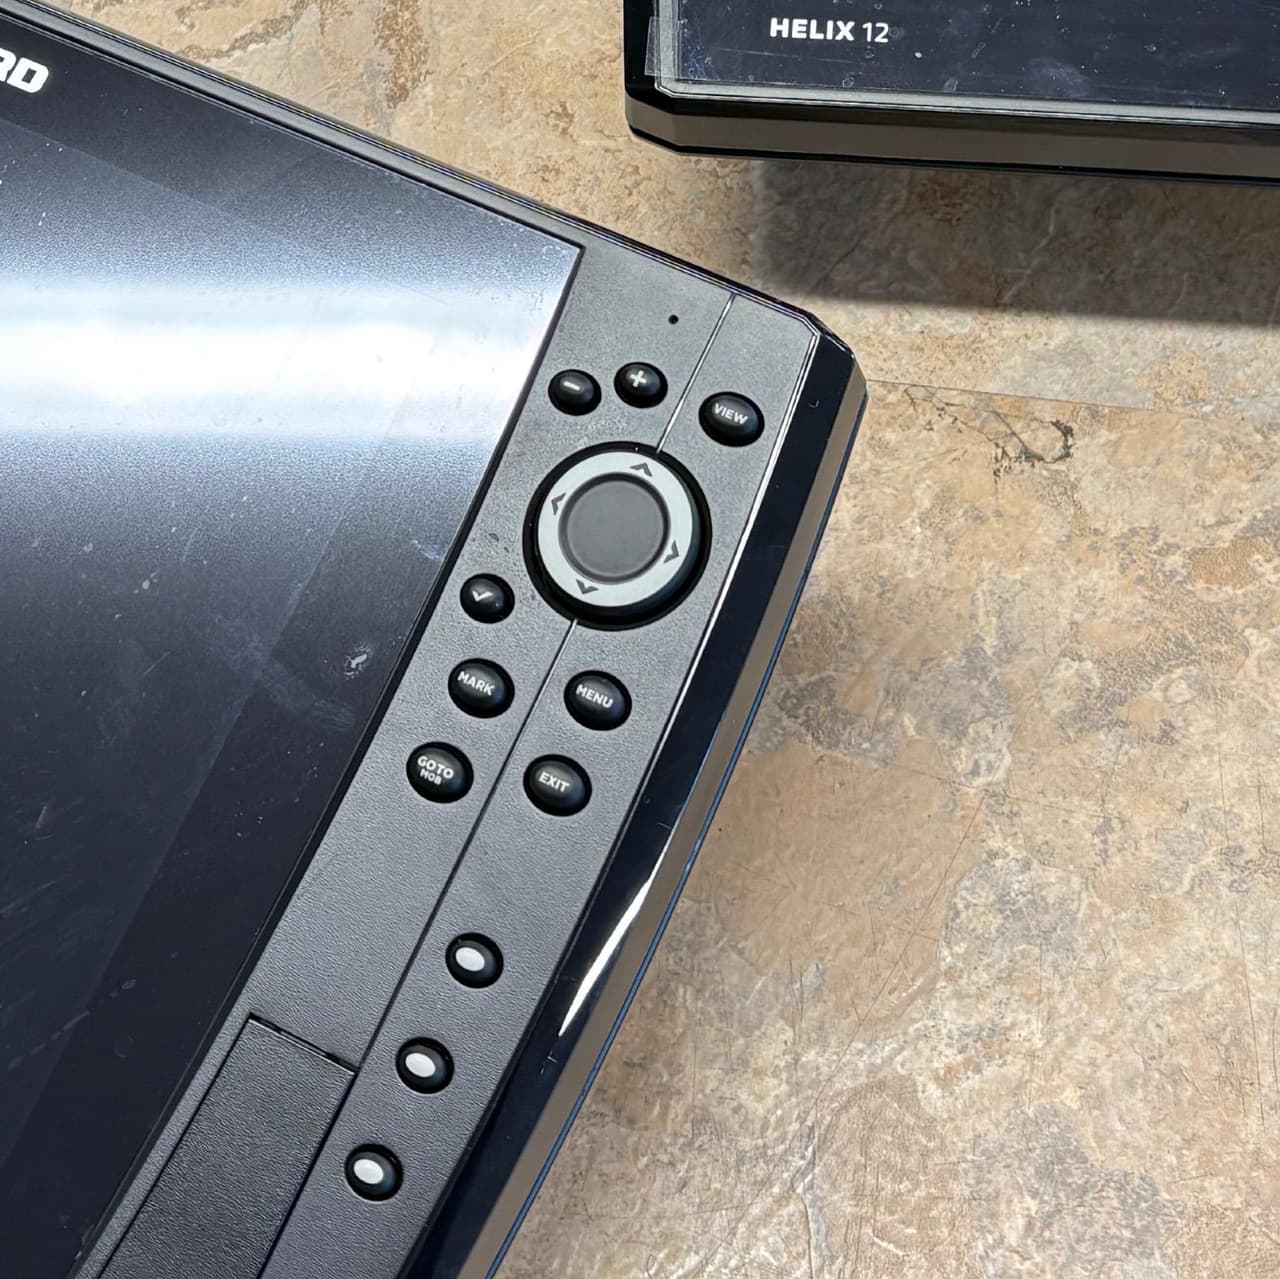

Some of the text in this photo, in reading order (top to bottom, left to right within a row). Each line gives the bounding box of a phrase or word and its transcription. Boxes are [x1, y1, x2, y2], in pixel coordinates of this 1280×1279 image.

[770, 17, 889, 43] HELIX 12
[713, 403, 749, 425] VIEW
[457, 670, 496, 697] MARK
[575, 682, 614, 710] MENU
[417, 755, 454, 779] GO TO
[420, 768, 442, 785] MOB
[538, 770, 570, 794] EXIT
